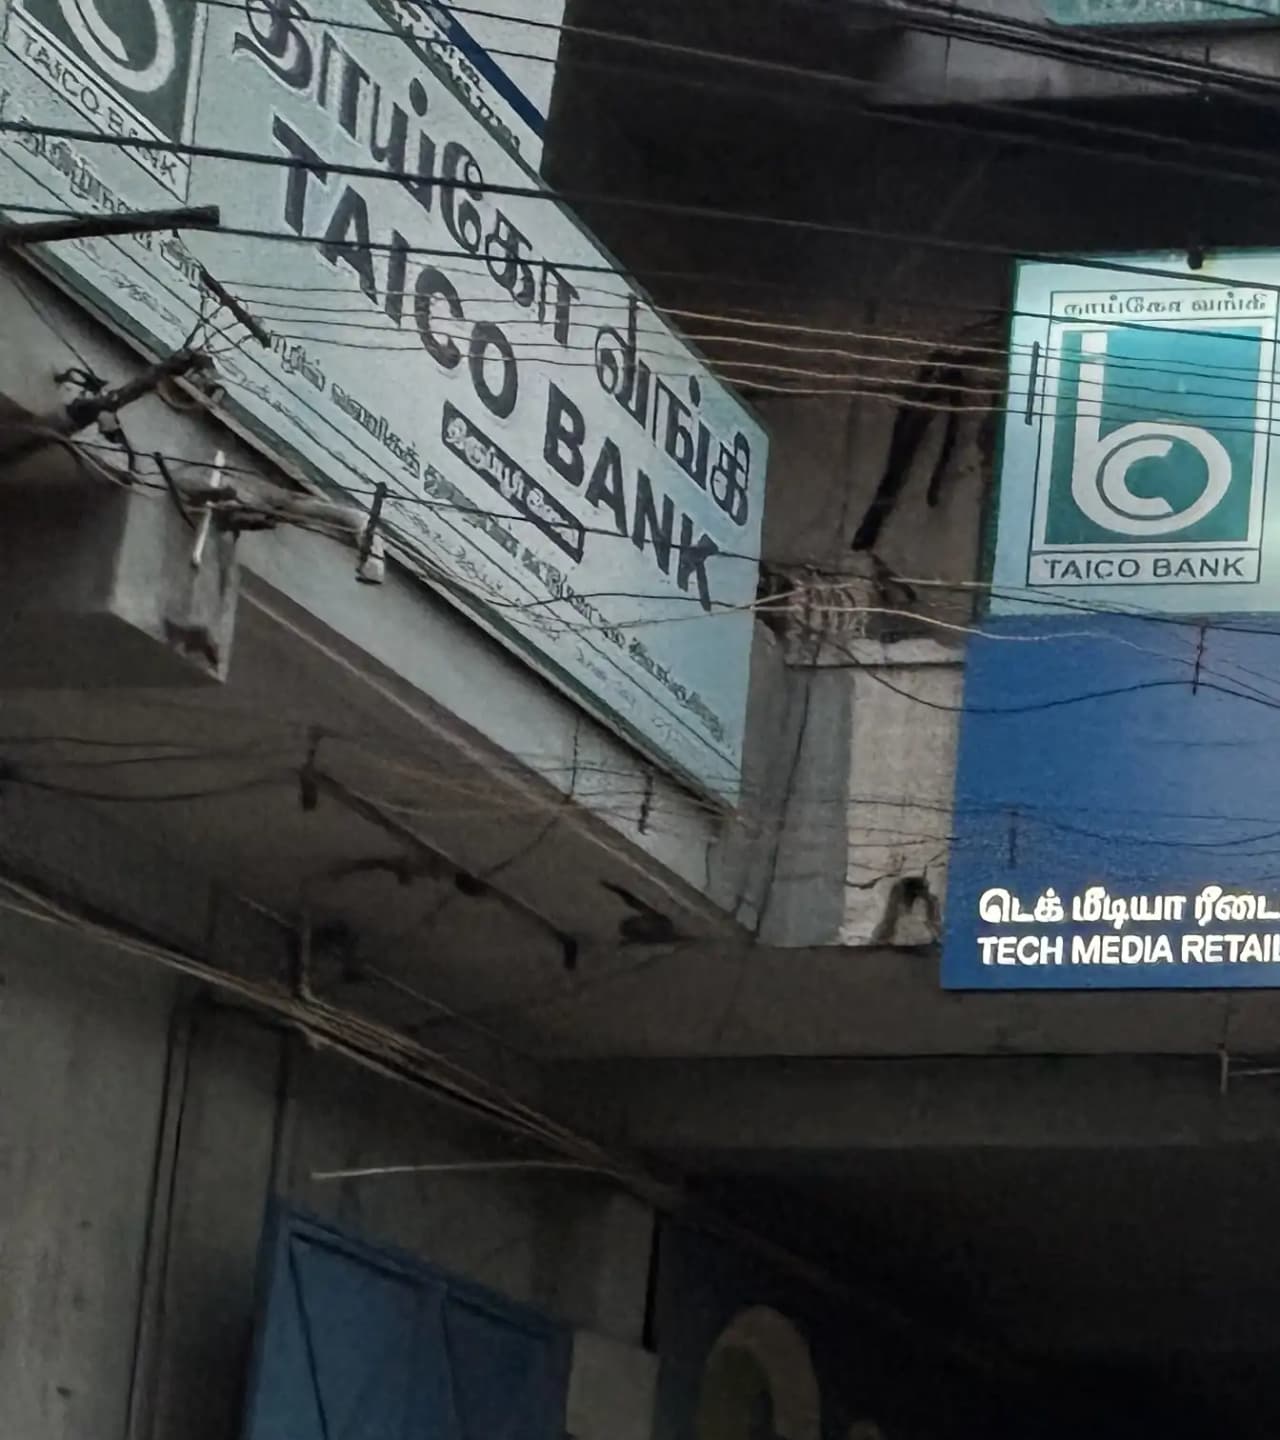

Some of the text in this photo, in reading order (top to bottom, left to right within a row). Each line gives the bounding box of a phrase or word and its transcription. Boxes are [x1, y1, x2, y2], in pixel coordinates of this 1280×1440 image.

[273, 114, 519, 418] TAICO
[543, 382, 722, 612] BANK
[1043, 556, 1245, 581] TAICO BANK
[978, 886, 1065, 923] டெக்
[1072, 886, 1187, 930] மீடியா
[976, 936, 1064, 966] TECH
[1071, 934, 1174, 965] MEDIA
